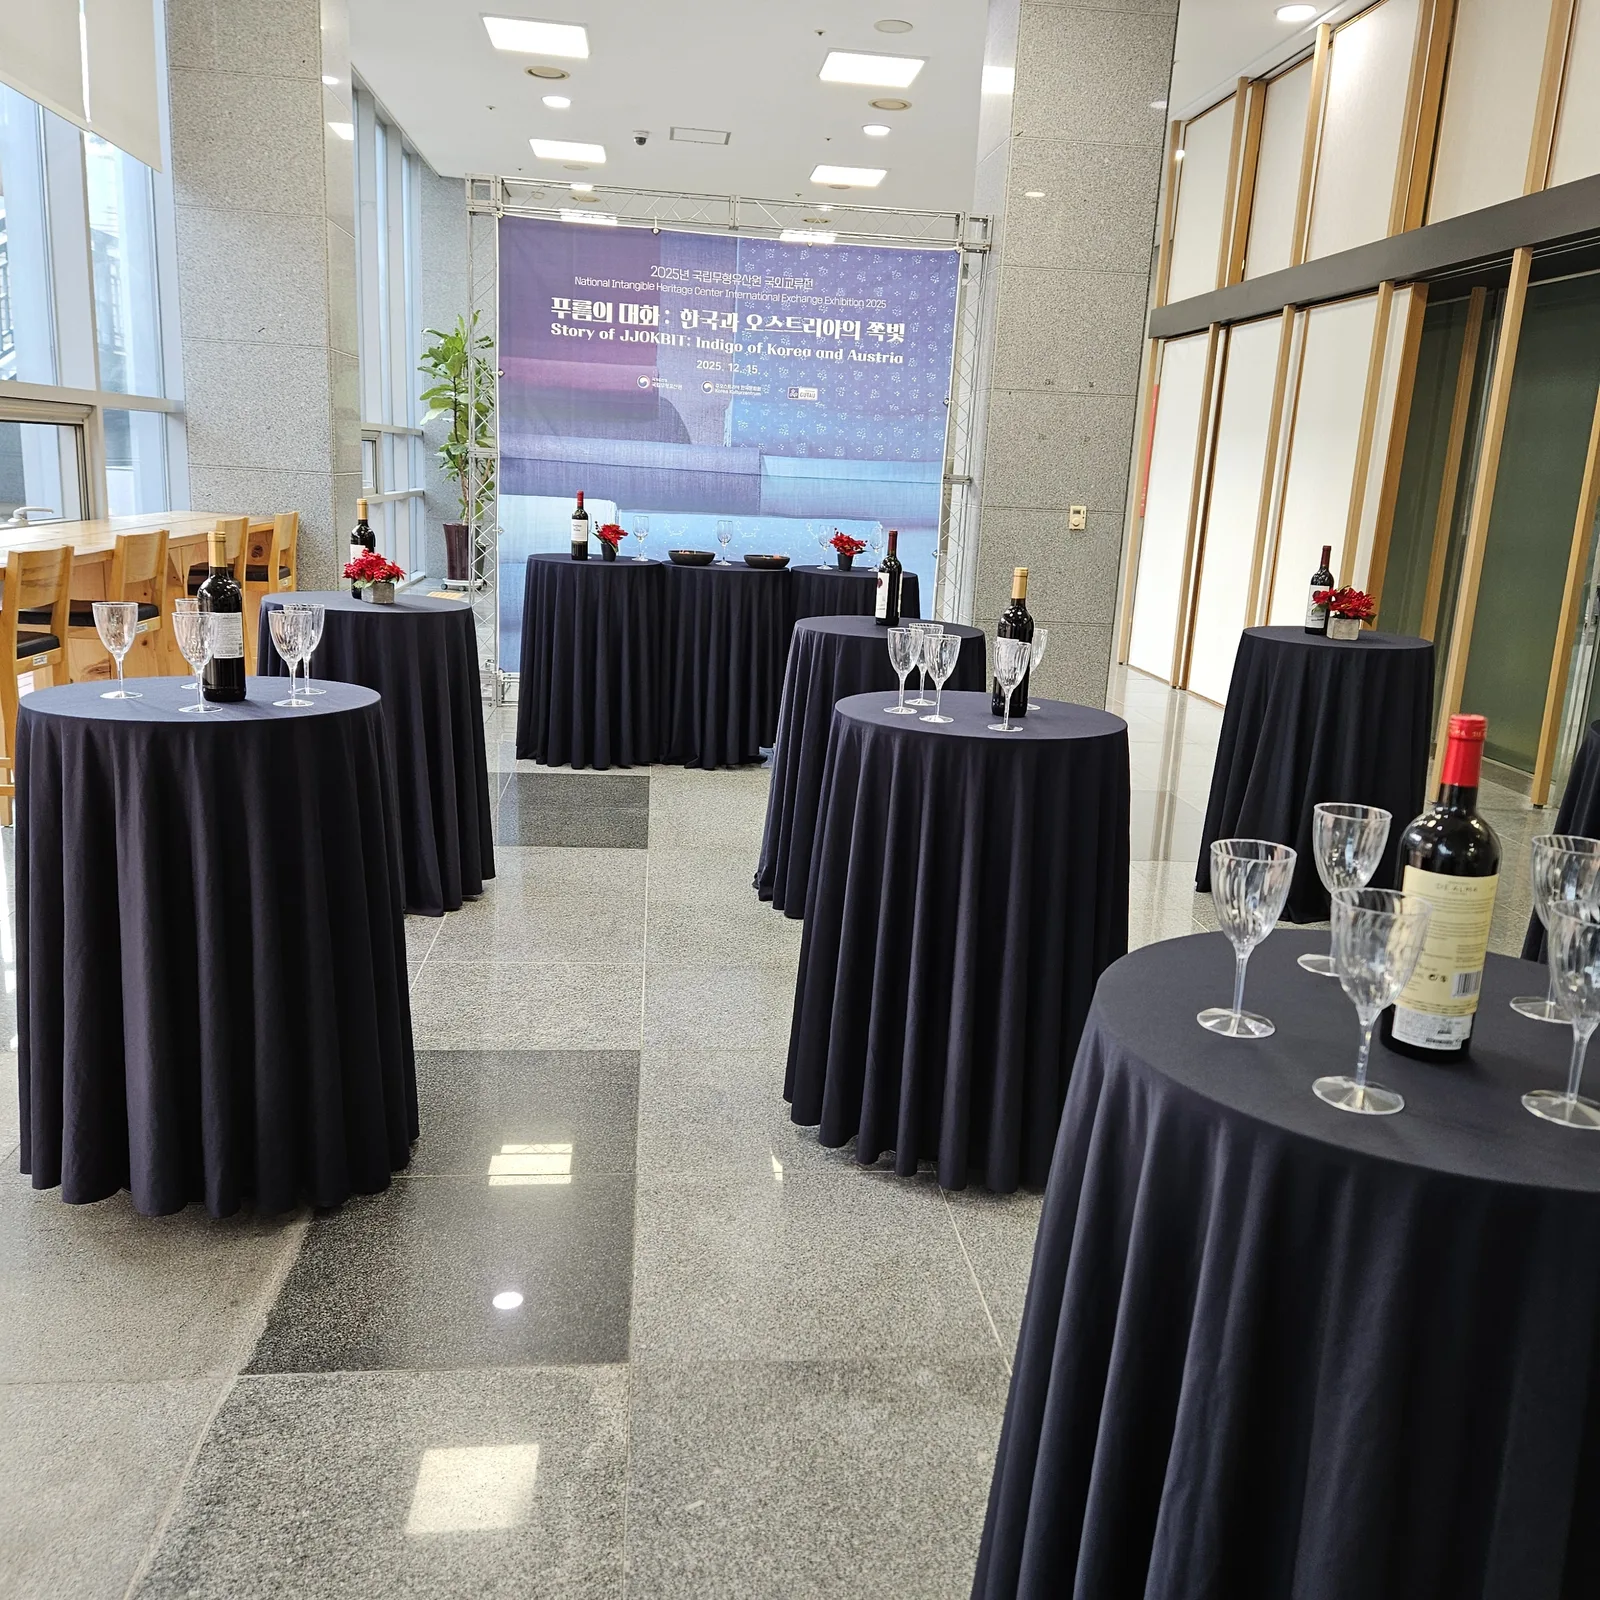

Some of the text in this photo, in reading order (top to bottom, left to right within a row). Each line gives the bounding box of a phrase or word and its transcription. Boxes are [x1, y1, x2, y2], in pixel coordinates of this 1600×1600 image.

[574, 276, 887, 309] National Intangible Heritage Center International Exchange Exhibition 2025
[650, 265, 814, 290] 2025년 국립무형유산원 국외교류전
[618, 302, 661, 327] 대화
[680, 308, 739, 333] 한국과
[744, 313, 861, 341] 오스트리아의
[866, 321, 906, 343] 쪽빛
[550, 322, 904, 364] Story of JJOKBIT: Indigo of Korea and Austria
[696, 359, 761, 374] 2025. 12. 15.
